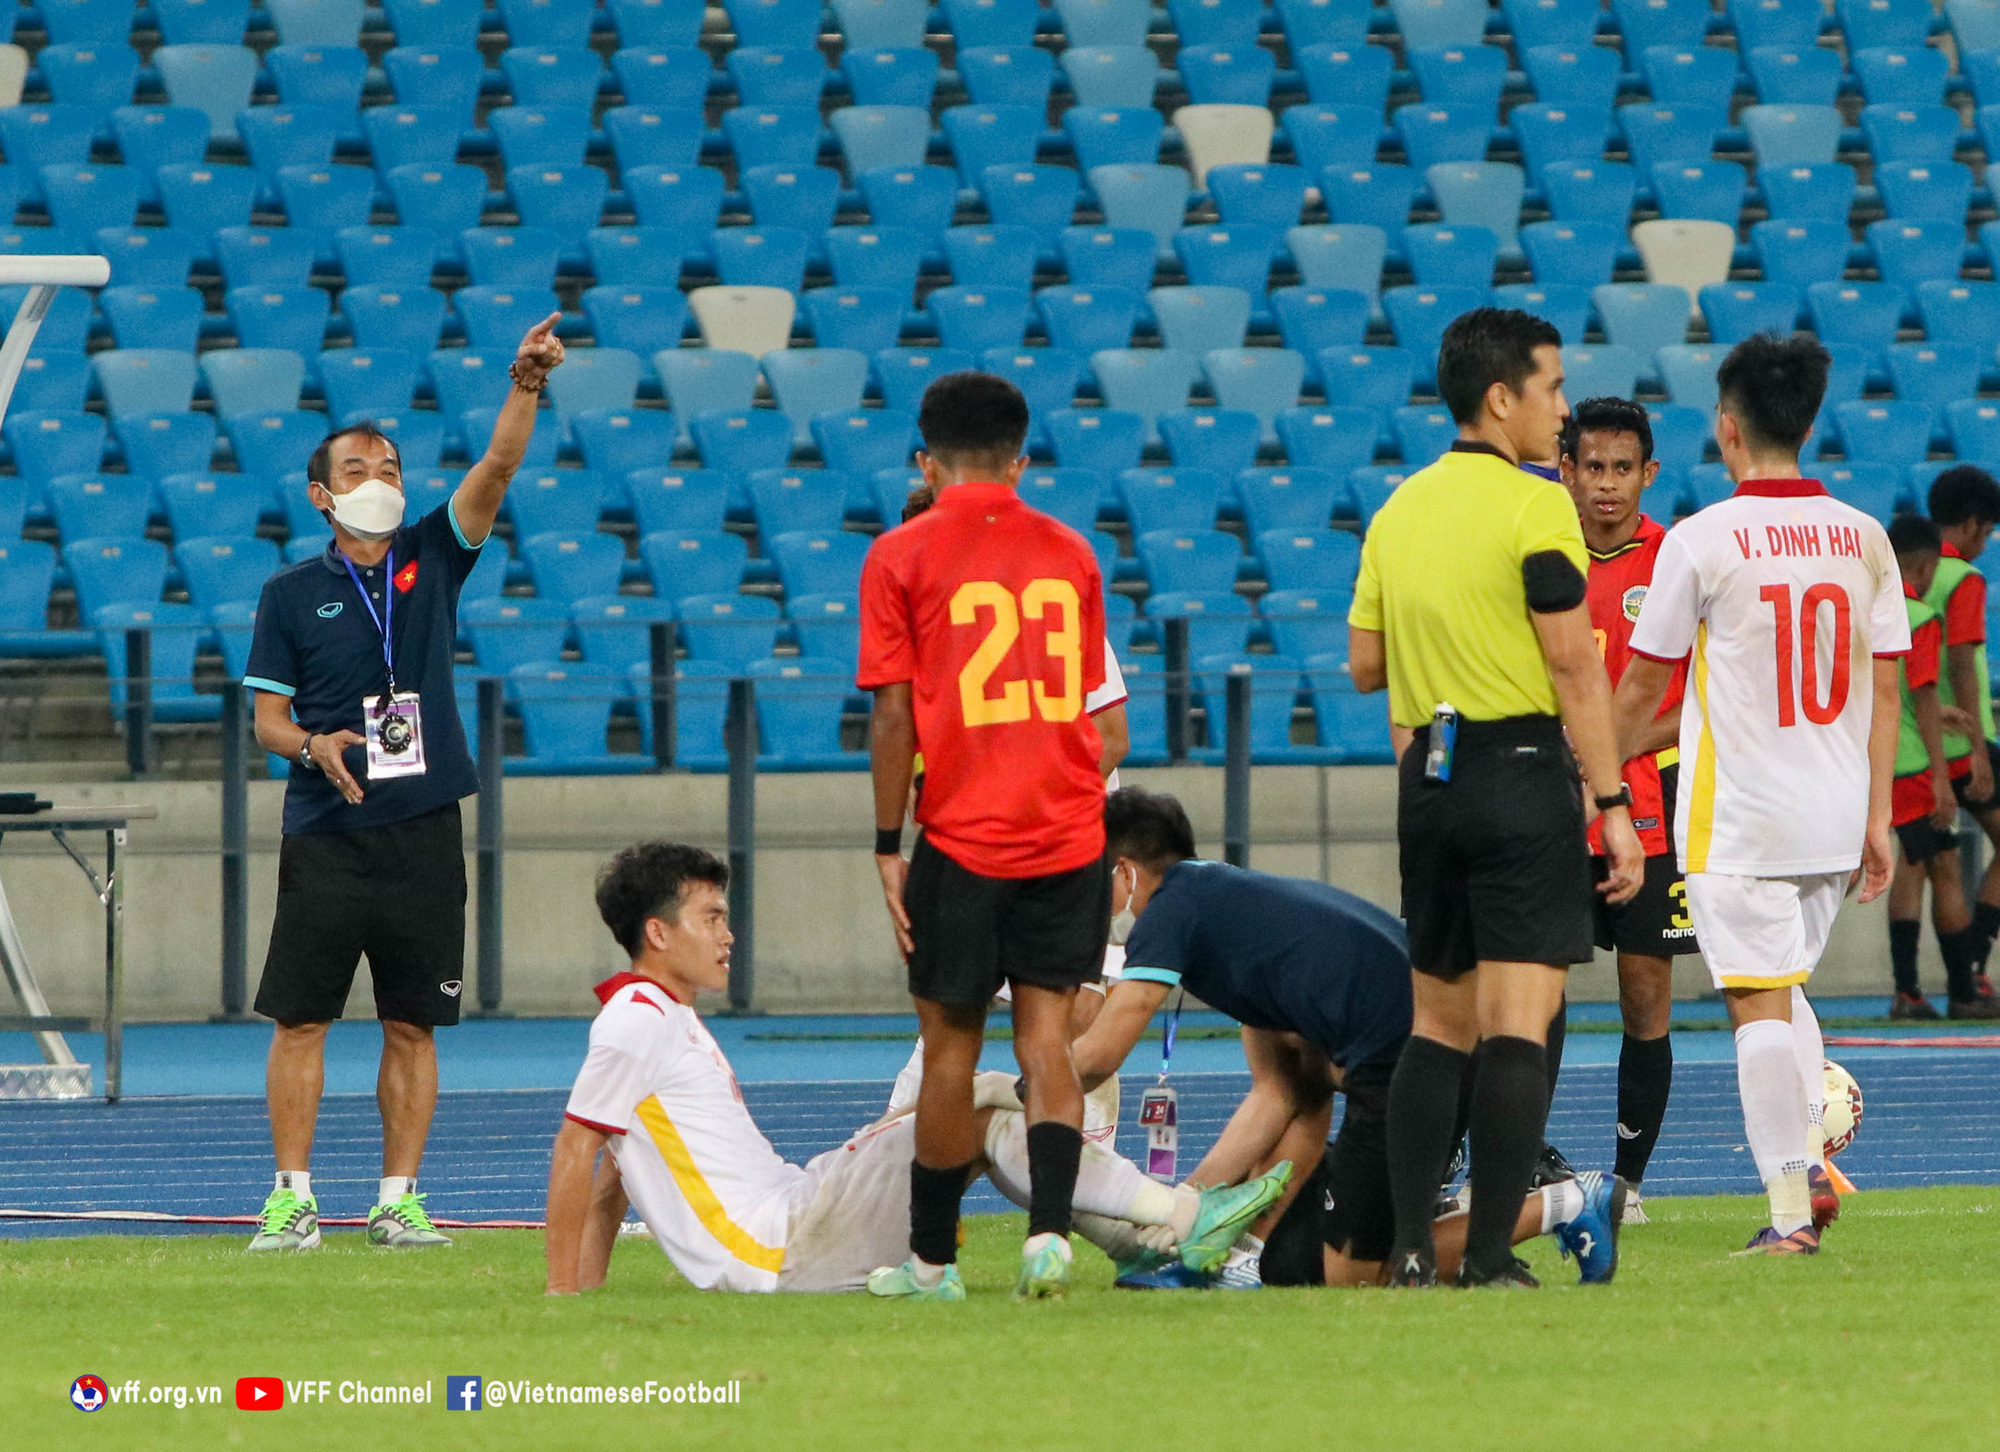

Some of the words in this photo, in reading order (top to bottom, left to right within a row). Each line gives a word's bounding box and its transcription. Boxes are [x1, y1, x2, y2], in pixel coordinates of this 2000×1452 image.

[1733, 527, 1762, 559] V.
[1765, 524, 1822, 557] DINH
[1827, 524, 1863, 560] HAI
[949, 578, 1083, 728] 23
[1760, 583, 1850, 727] 10
